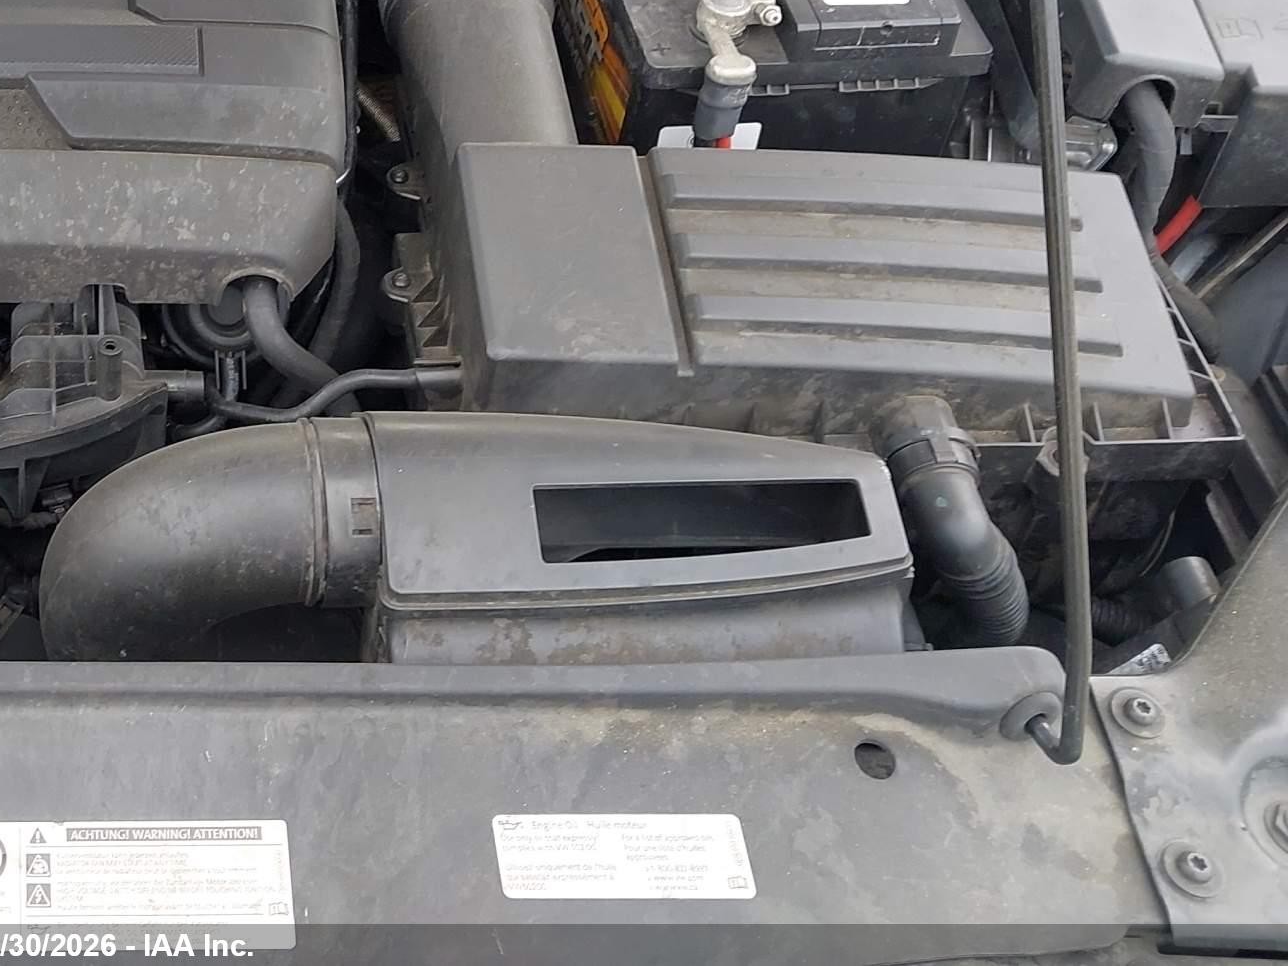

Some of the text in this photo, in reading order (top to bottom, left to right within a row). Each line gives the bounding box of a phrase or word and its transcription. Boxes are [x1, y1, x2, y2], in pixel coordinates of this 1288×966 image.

[70, 827, 258, 841] ACHTUNG! WARNING! ATTENTION!
